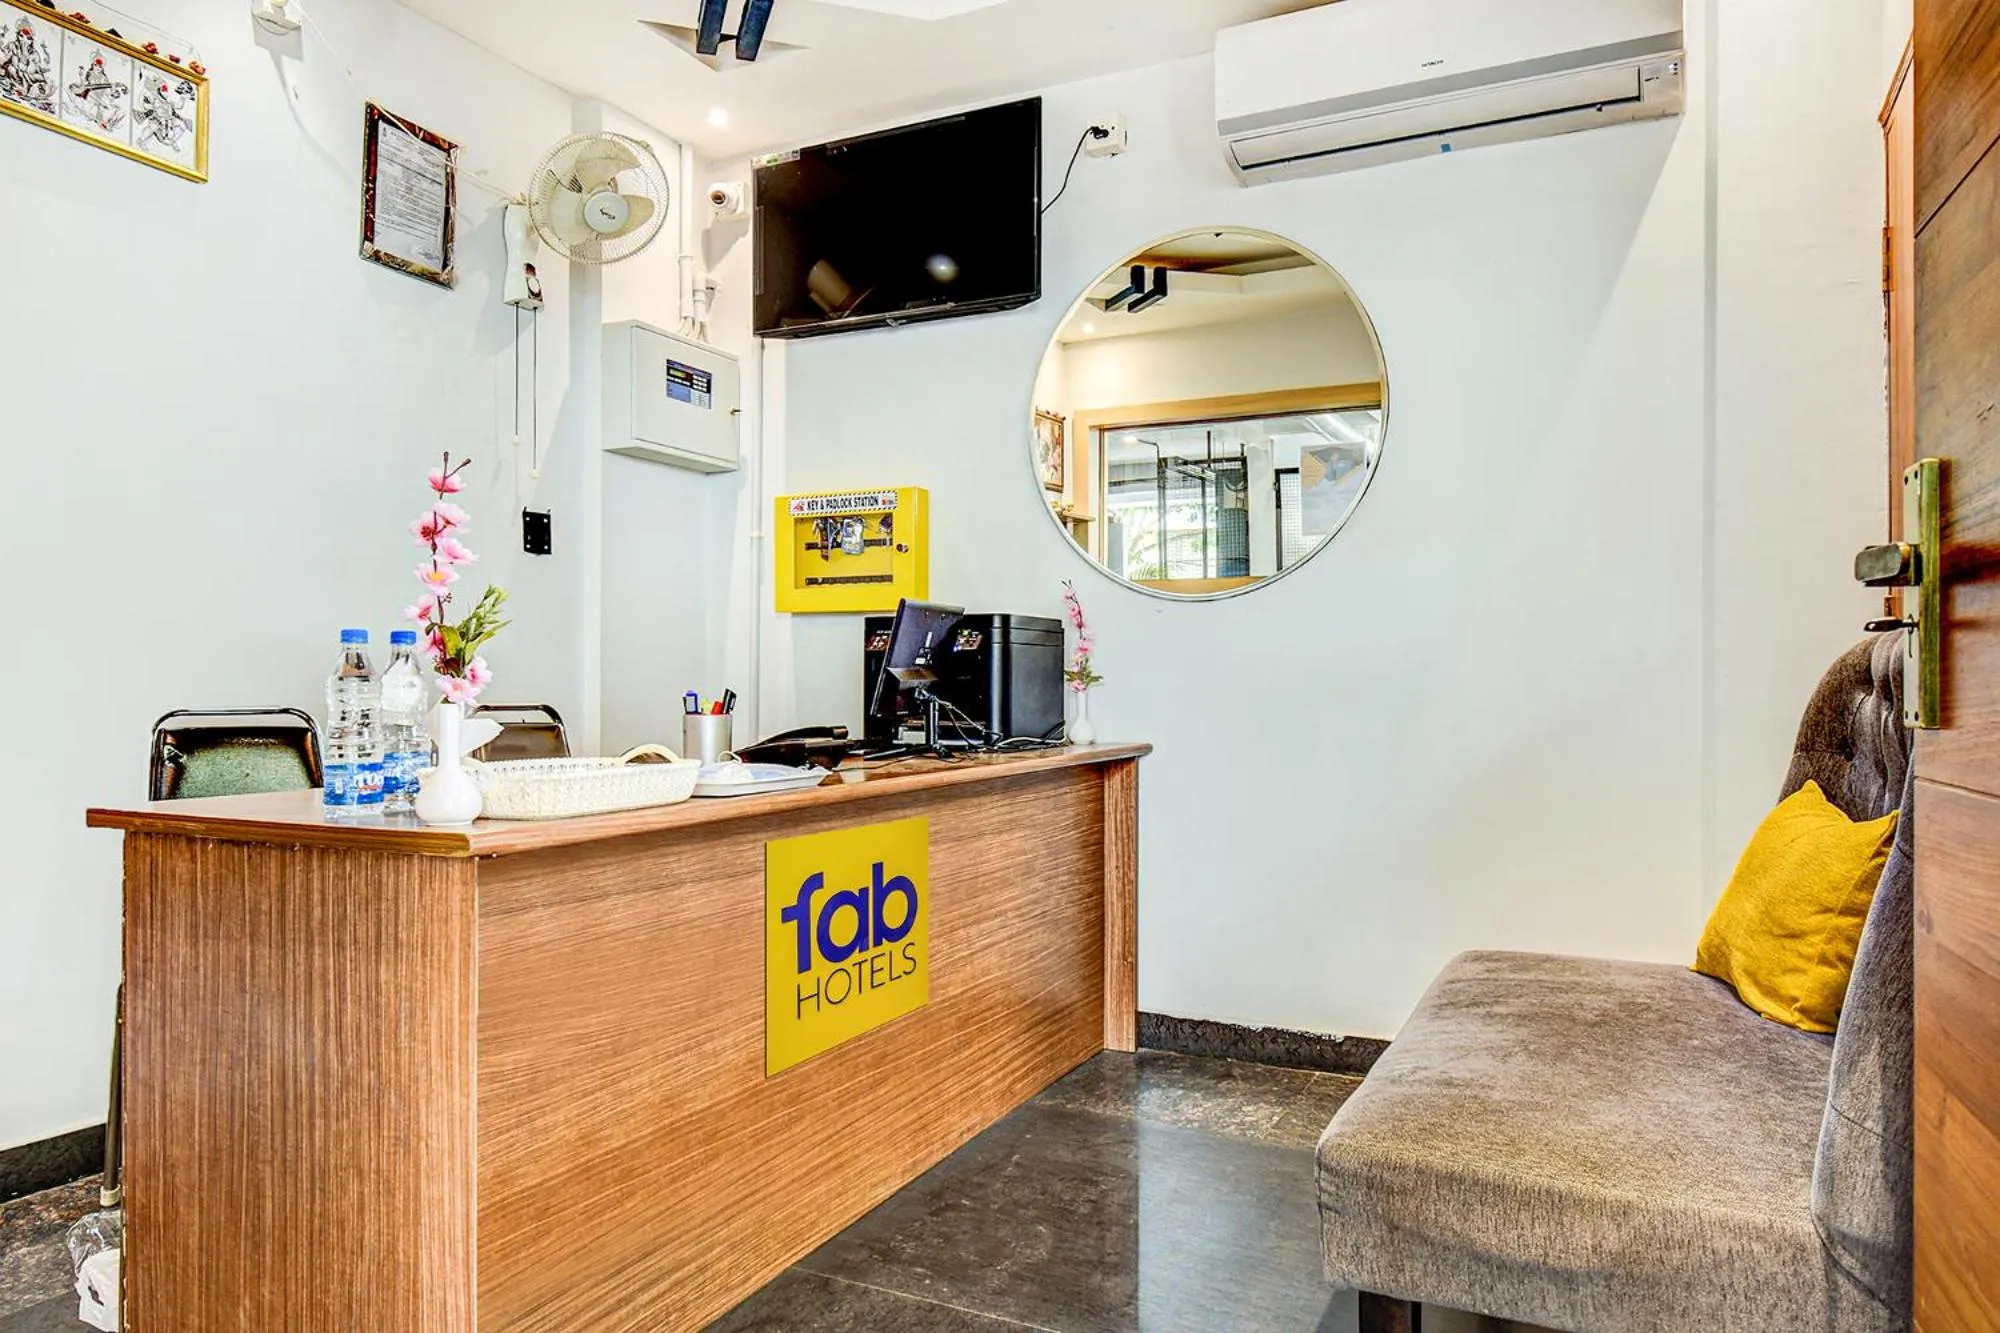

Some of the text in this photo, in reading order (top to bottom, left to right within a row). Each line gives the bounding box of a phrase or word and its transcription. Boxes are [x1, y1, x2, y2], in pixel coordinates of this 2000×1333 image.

[807, 500, 818, 511] KEY
[820, 500, 825, 510] &
[826, 498, 852, 510] PADLOCK
[854, 496, 880, 508] STATION
[781, 861, 918, 975] fab
[796, 942, 917, 1020] HOTELS
